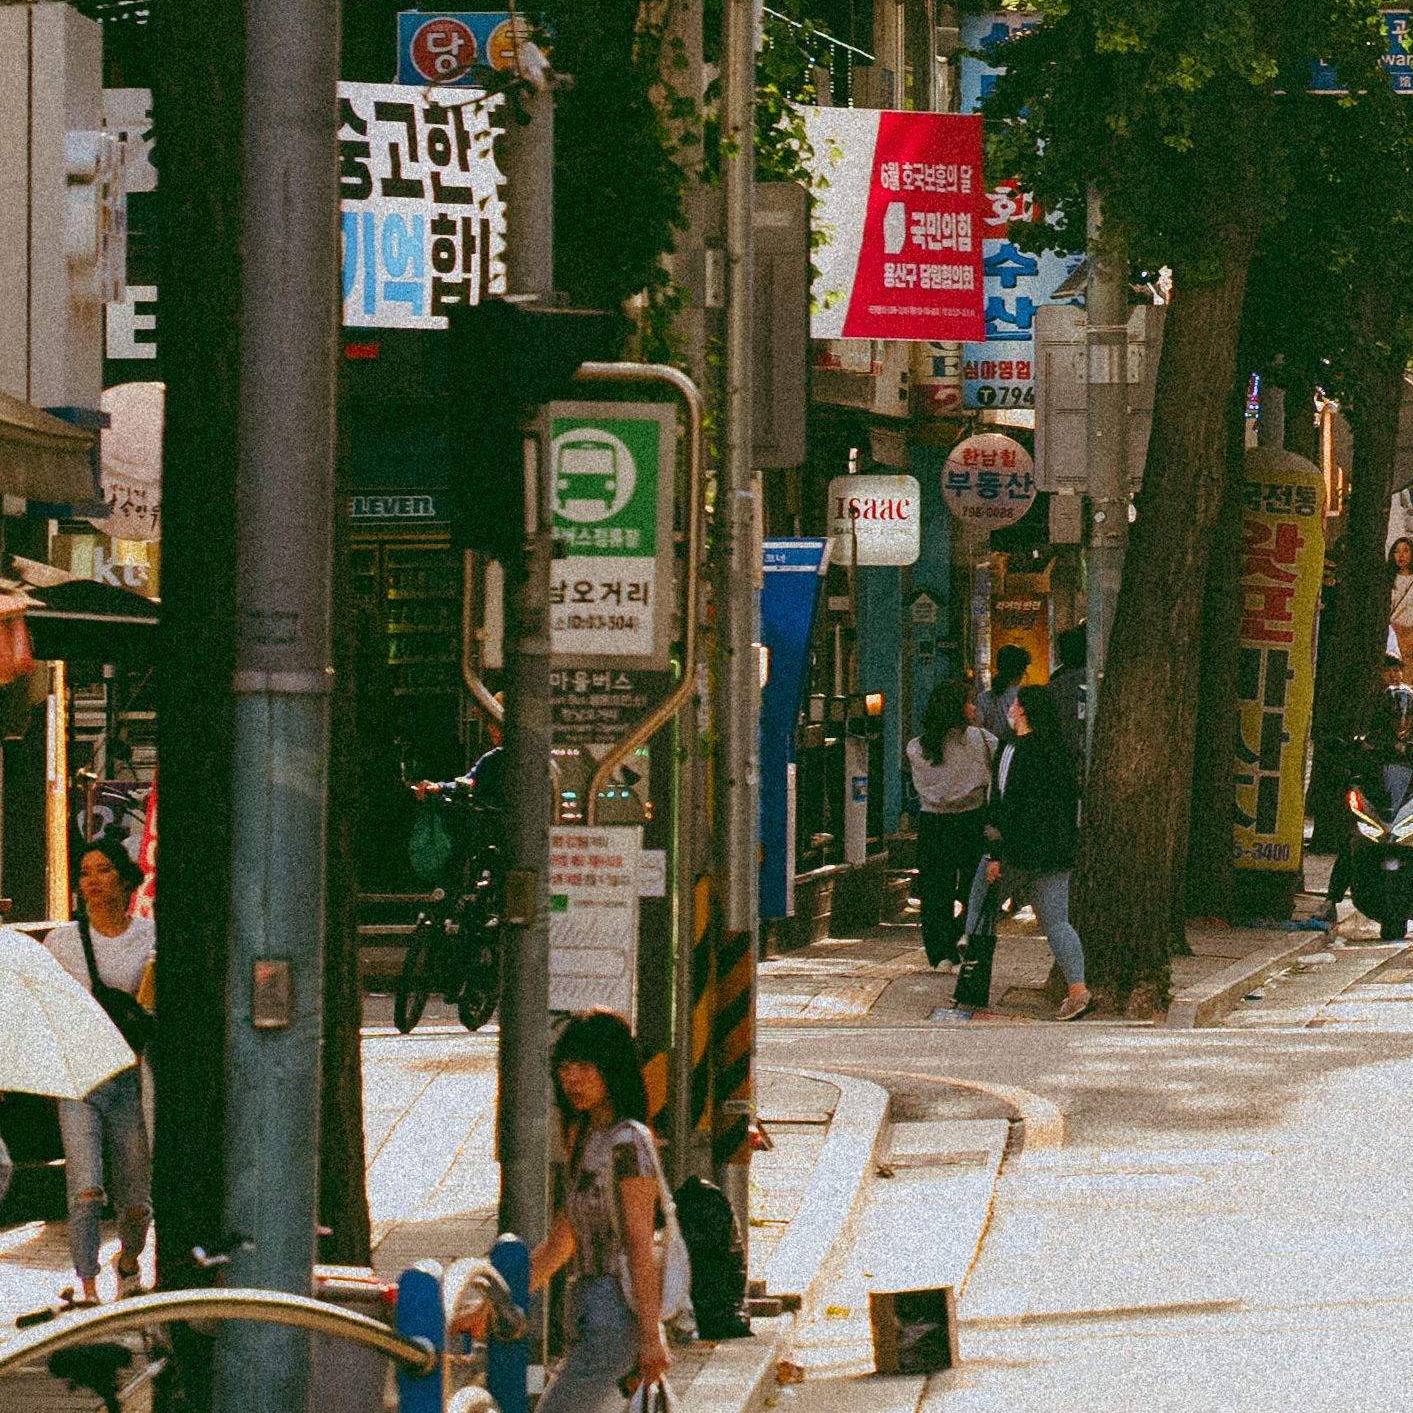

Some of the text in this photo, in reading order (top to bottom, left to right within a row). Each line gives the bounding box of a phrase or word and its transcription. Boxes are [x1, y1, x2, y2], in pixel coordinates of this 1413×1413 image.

[910, 210, 973, 253] 국민의힘
[963, 360, 1032, 381] 심야영업
[944, 470, 1035, 501] 부동산
